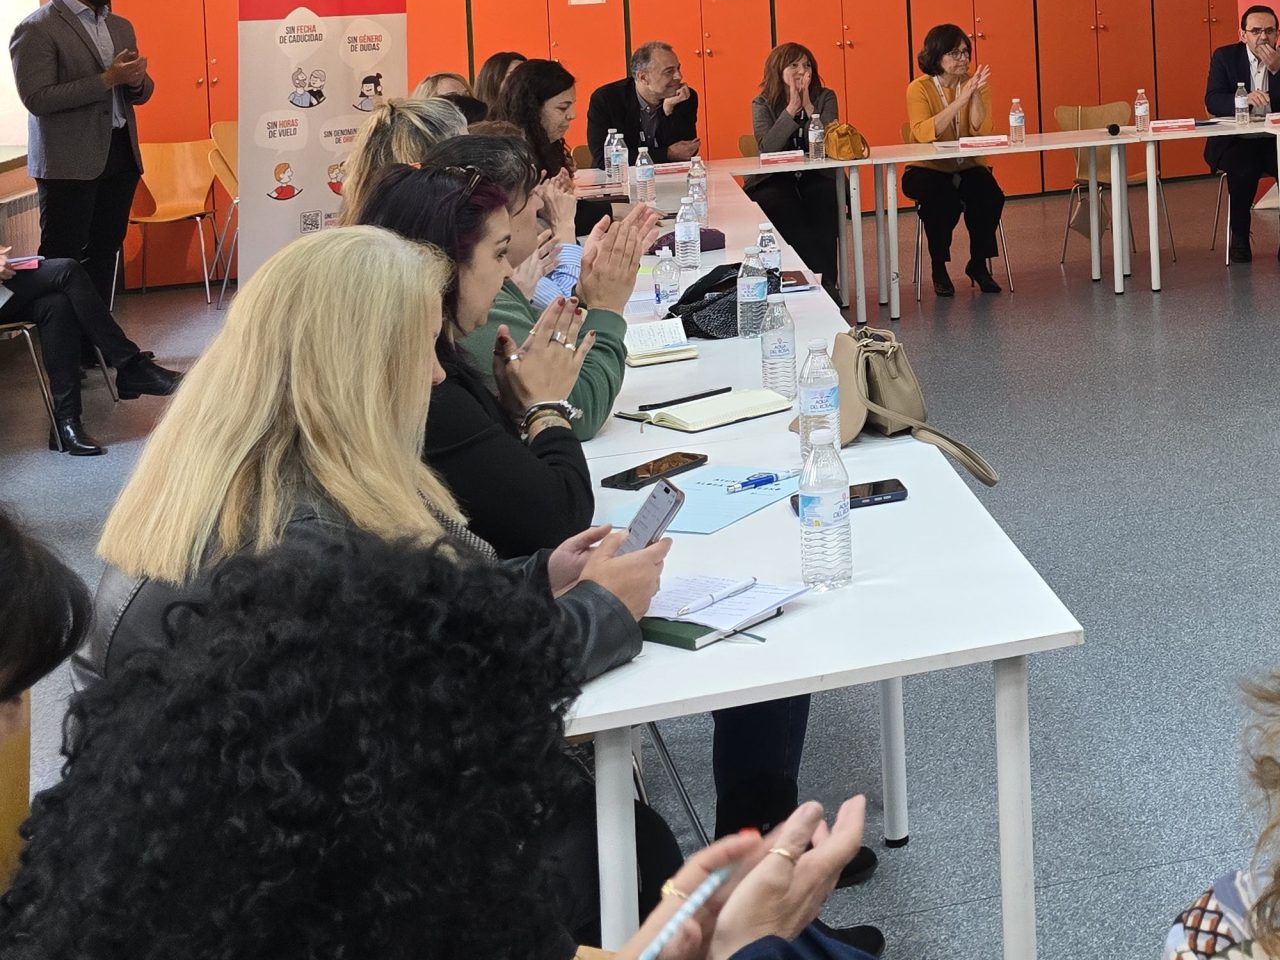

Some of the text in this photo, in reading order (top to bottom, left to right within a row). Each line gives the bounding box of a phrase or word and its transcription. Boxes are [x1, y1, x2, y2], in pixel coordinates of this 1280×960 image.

[285, 25, 317, 35] SIN FECHA
[279, 33, 323, 44] DE CADUCIDAD
[347, 34, 383, 44] SIN GÉNERO
[350, 43, 380, 52] DE DUDAS
[266, 119, 299, 130] SIN HORAS
[268, 128, 297, 139] DE VUELO
